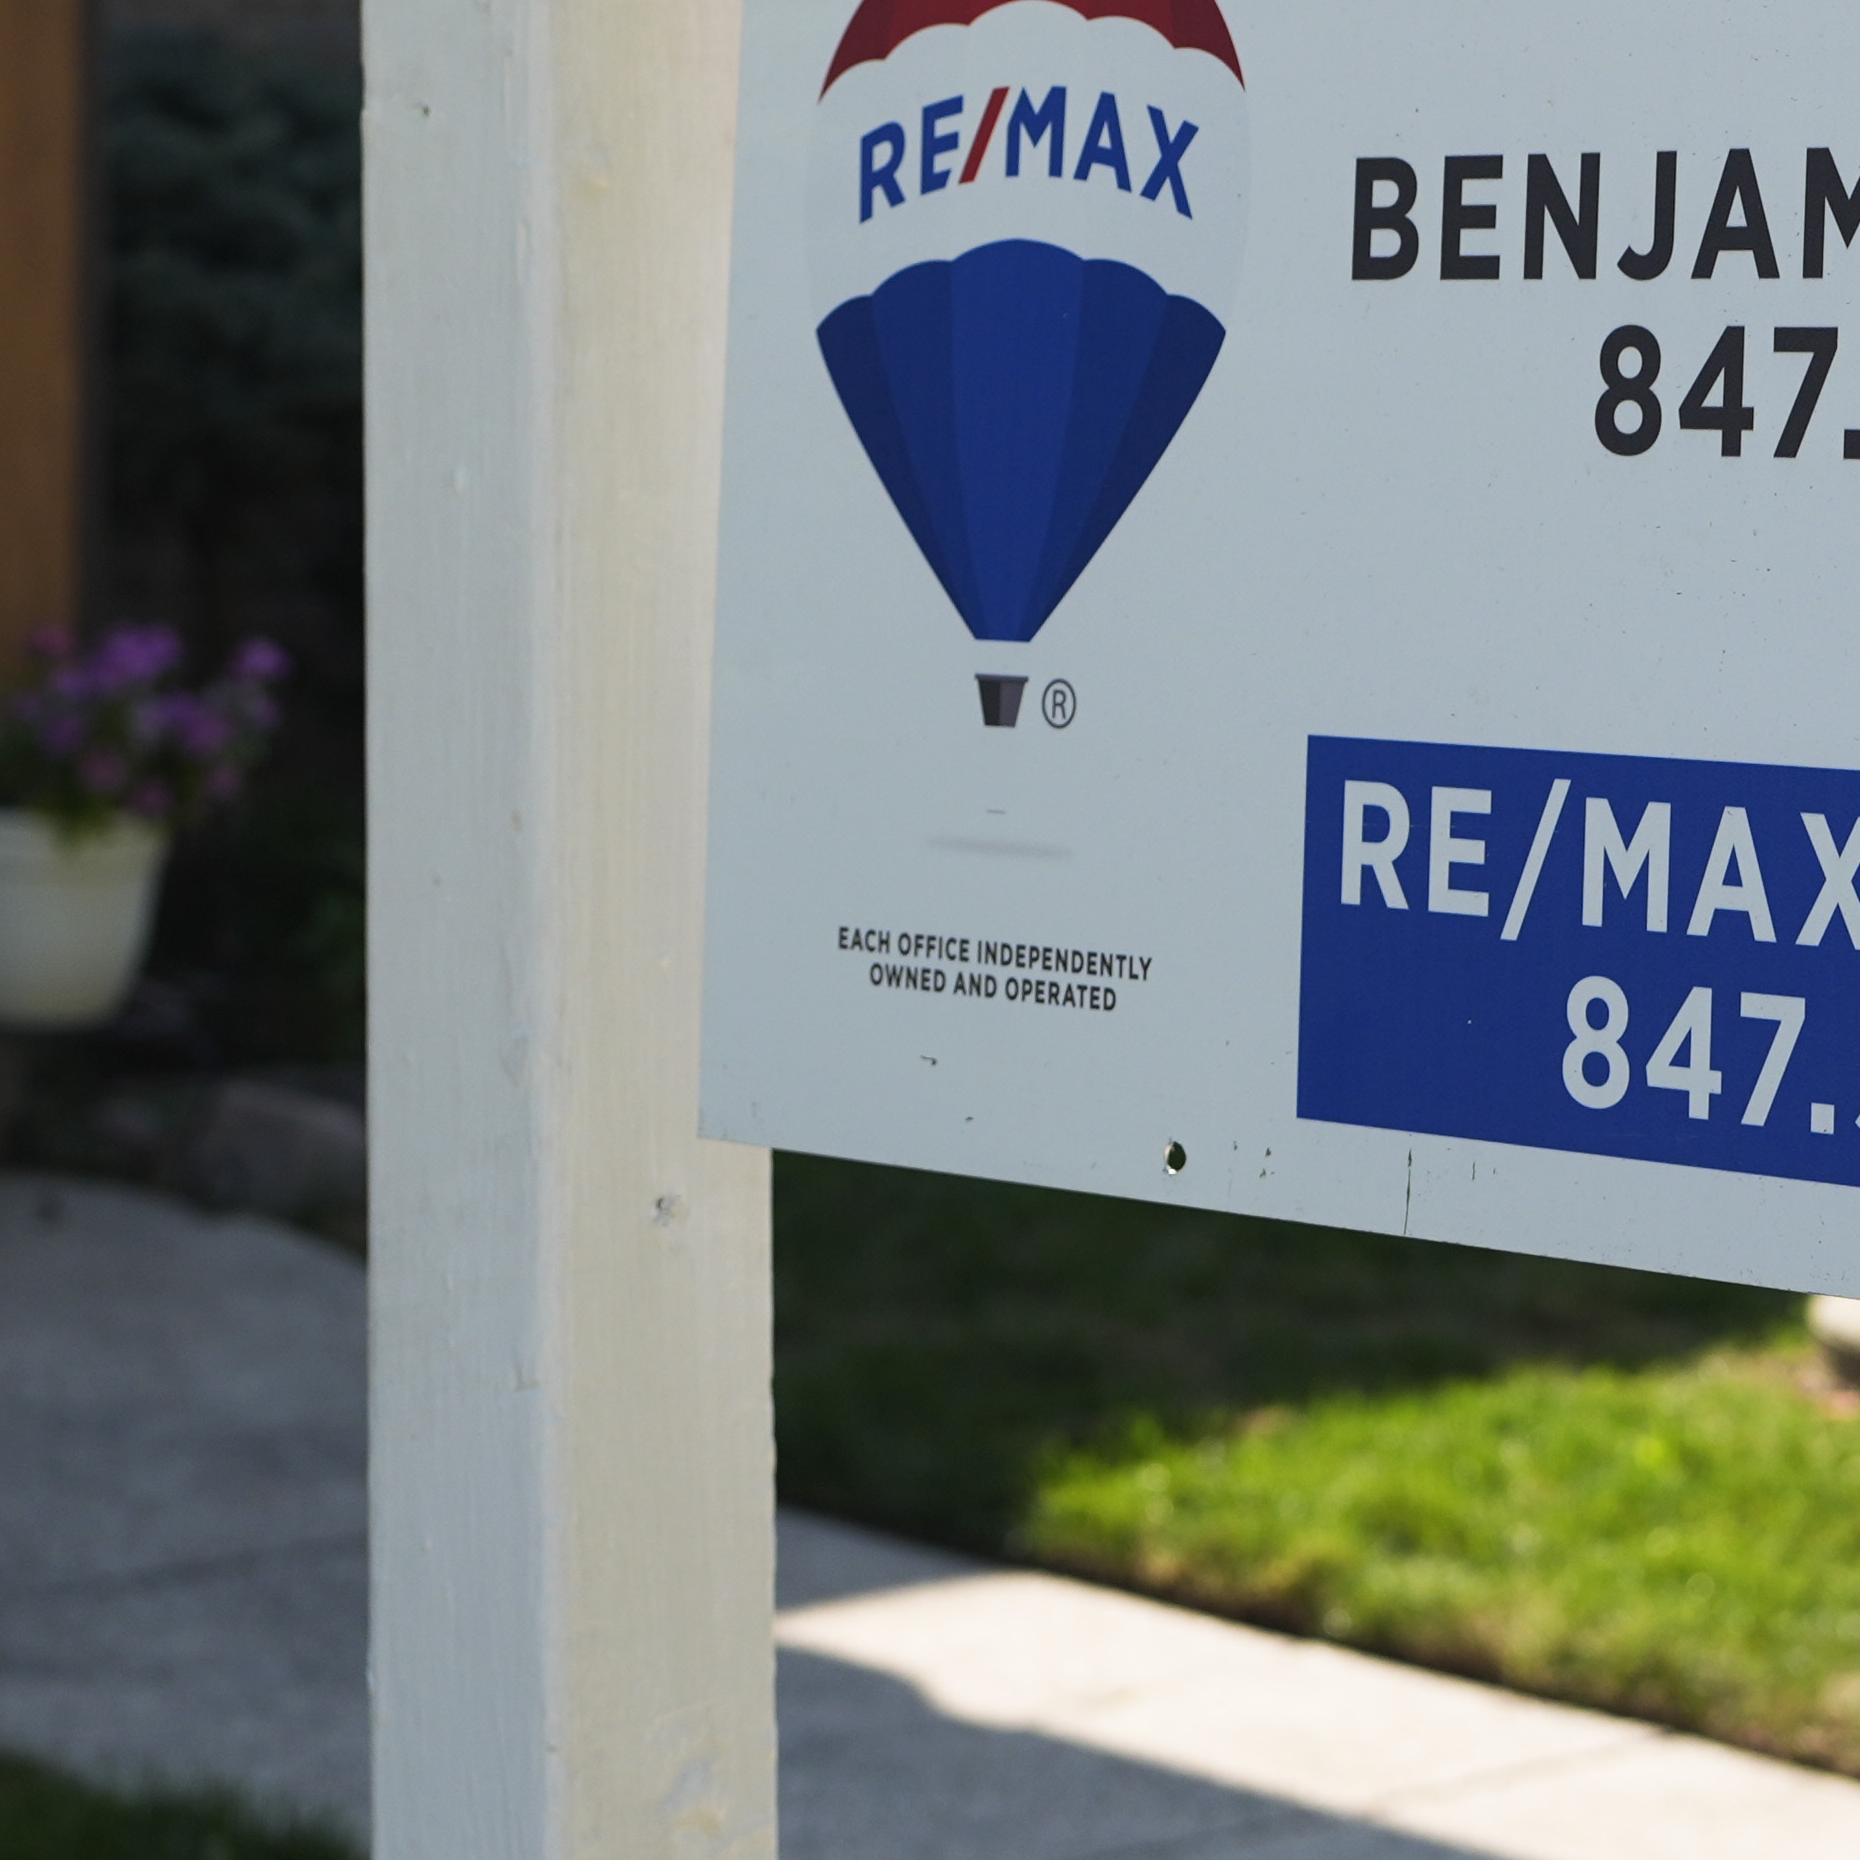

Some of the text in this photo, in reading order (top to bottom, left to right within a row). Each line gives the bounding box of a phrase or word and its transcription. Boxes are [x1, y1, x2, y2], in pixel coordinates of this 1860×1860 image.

[858, 84, 1200, 225] RE/MAX
[837, 925, 1154, 983] EACH OFFICE INDEPENDENTLY
[868, 961, 1118, 1013] OWNED AND OPERATED
